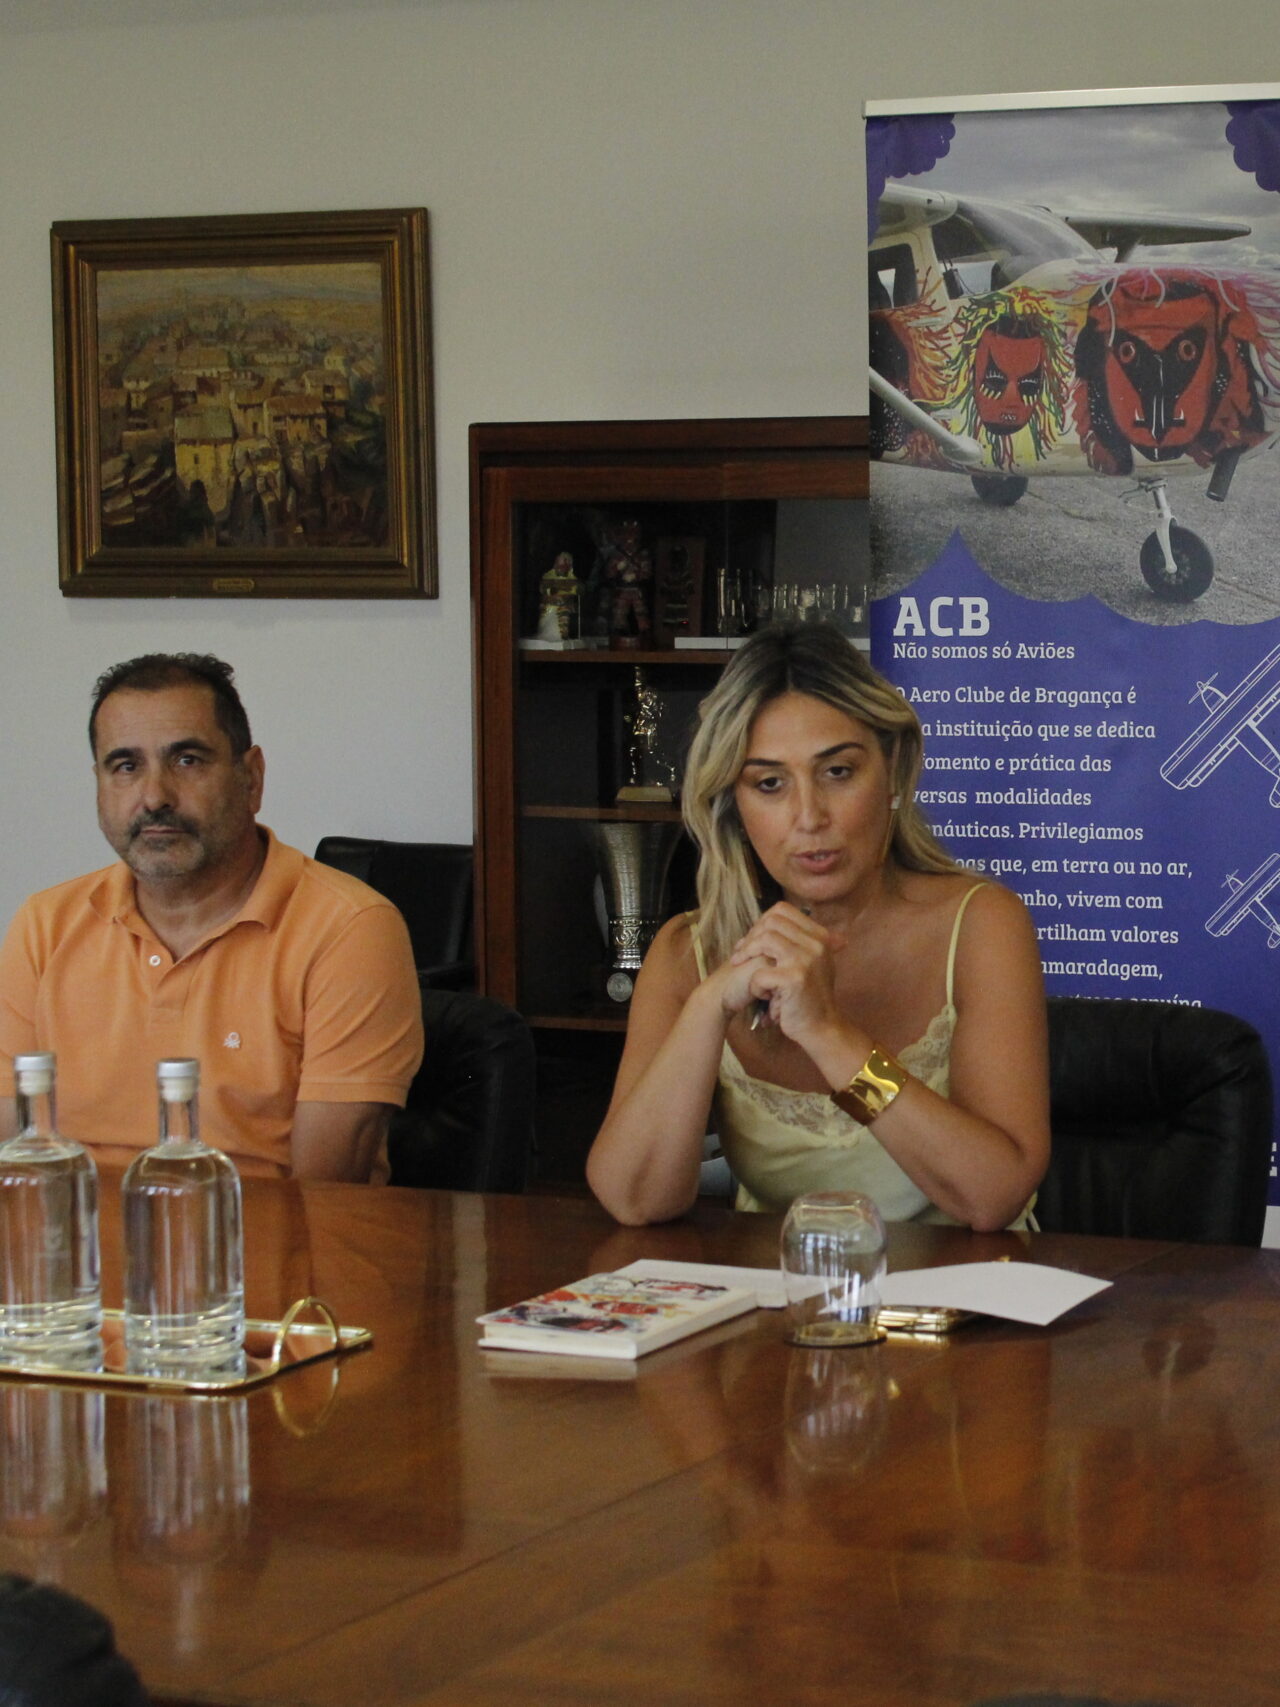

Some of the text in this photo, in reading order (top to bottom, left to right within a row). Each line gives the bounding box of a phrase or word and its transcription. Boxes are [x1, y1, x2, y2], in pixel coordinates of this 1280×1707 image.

[893, 596, 990, 637] ACB
[893, 641, 1075, 661] Não somos só Aviões
[909, 687, 950, 703] Aero
[955, 686, 1005, 703] Clube
[1009, 687, 1030, 704] de
[1035, 687, 1123, 708] Bragança
[1127, 686, 1137, 704] é
[936, 720, 1033, 741] instituição
[1037, 724, 1069, 741] que
[1074, 725, 1092, 738] se
[1096, 721, 1156, 738] dedica
[922, 754, 1112, 775] omento e prática das
[975, 788, 1092, 805] modalidades
[931, 819, 1144, 843] náuticas. Privilegiamos
[990, 858, 1027, 875] que,
[1031, 859, 1058, 873] em
[1062, 857, 1109, 874] terra
[1113, 862, 1135, 874] ou
[1139, 862, 1162, 875] no
[1166, 862, 1193, 878] ar,
[1066, 890, 1121, 907] vivem
[1125, 896, 1163, 909] com
[1036, 923, 1179, 944] rtilham valores
